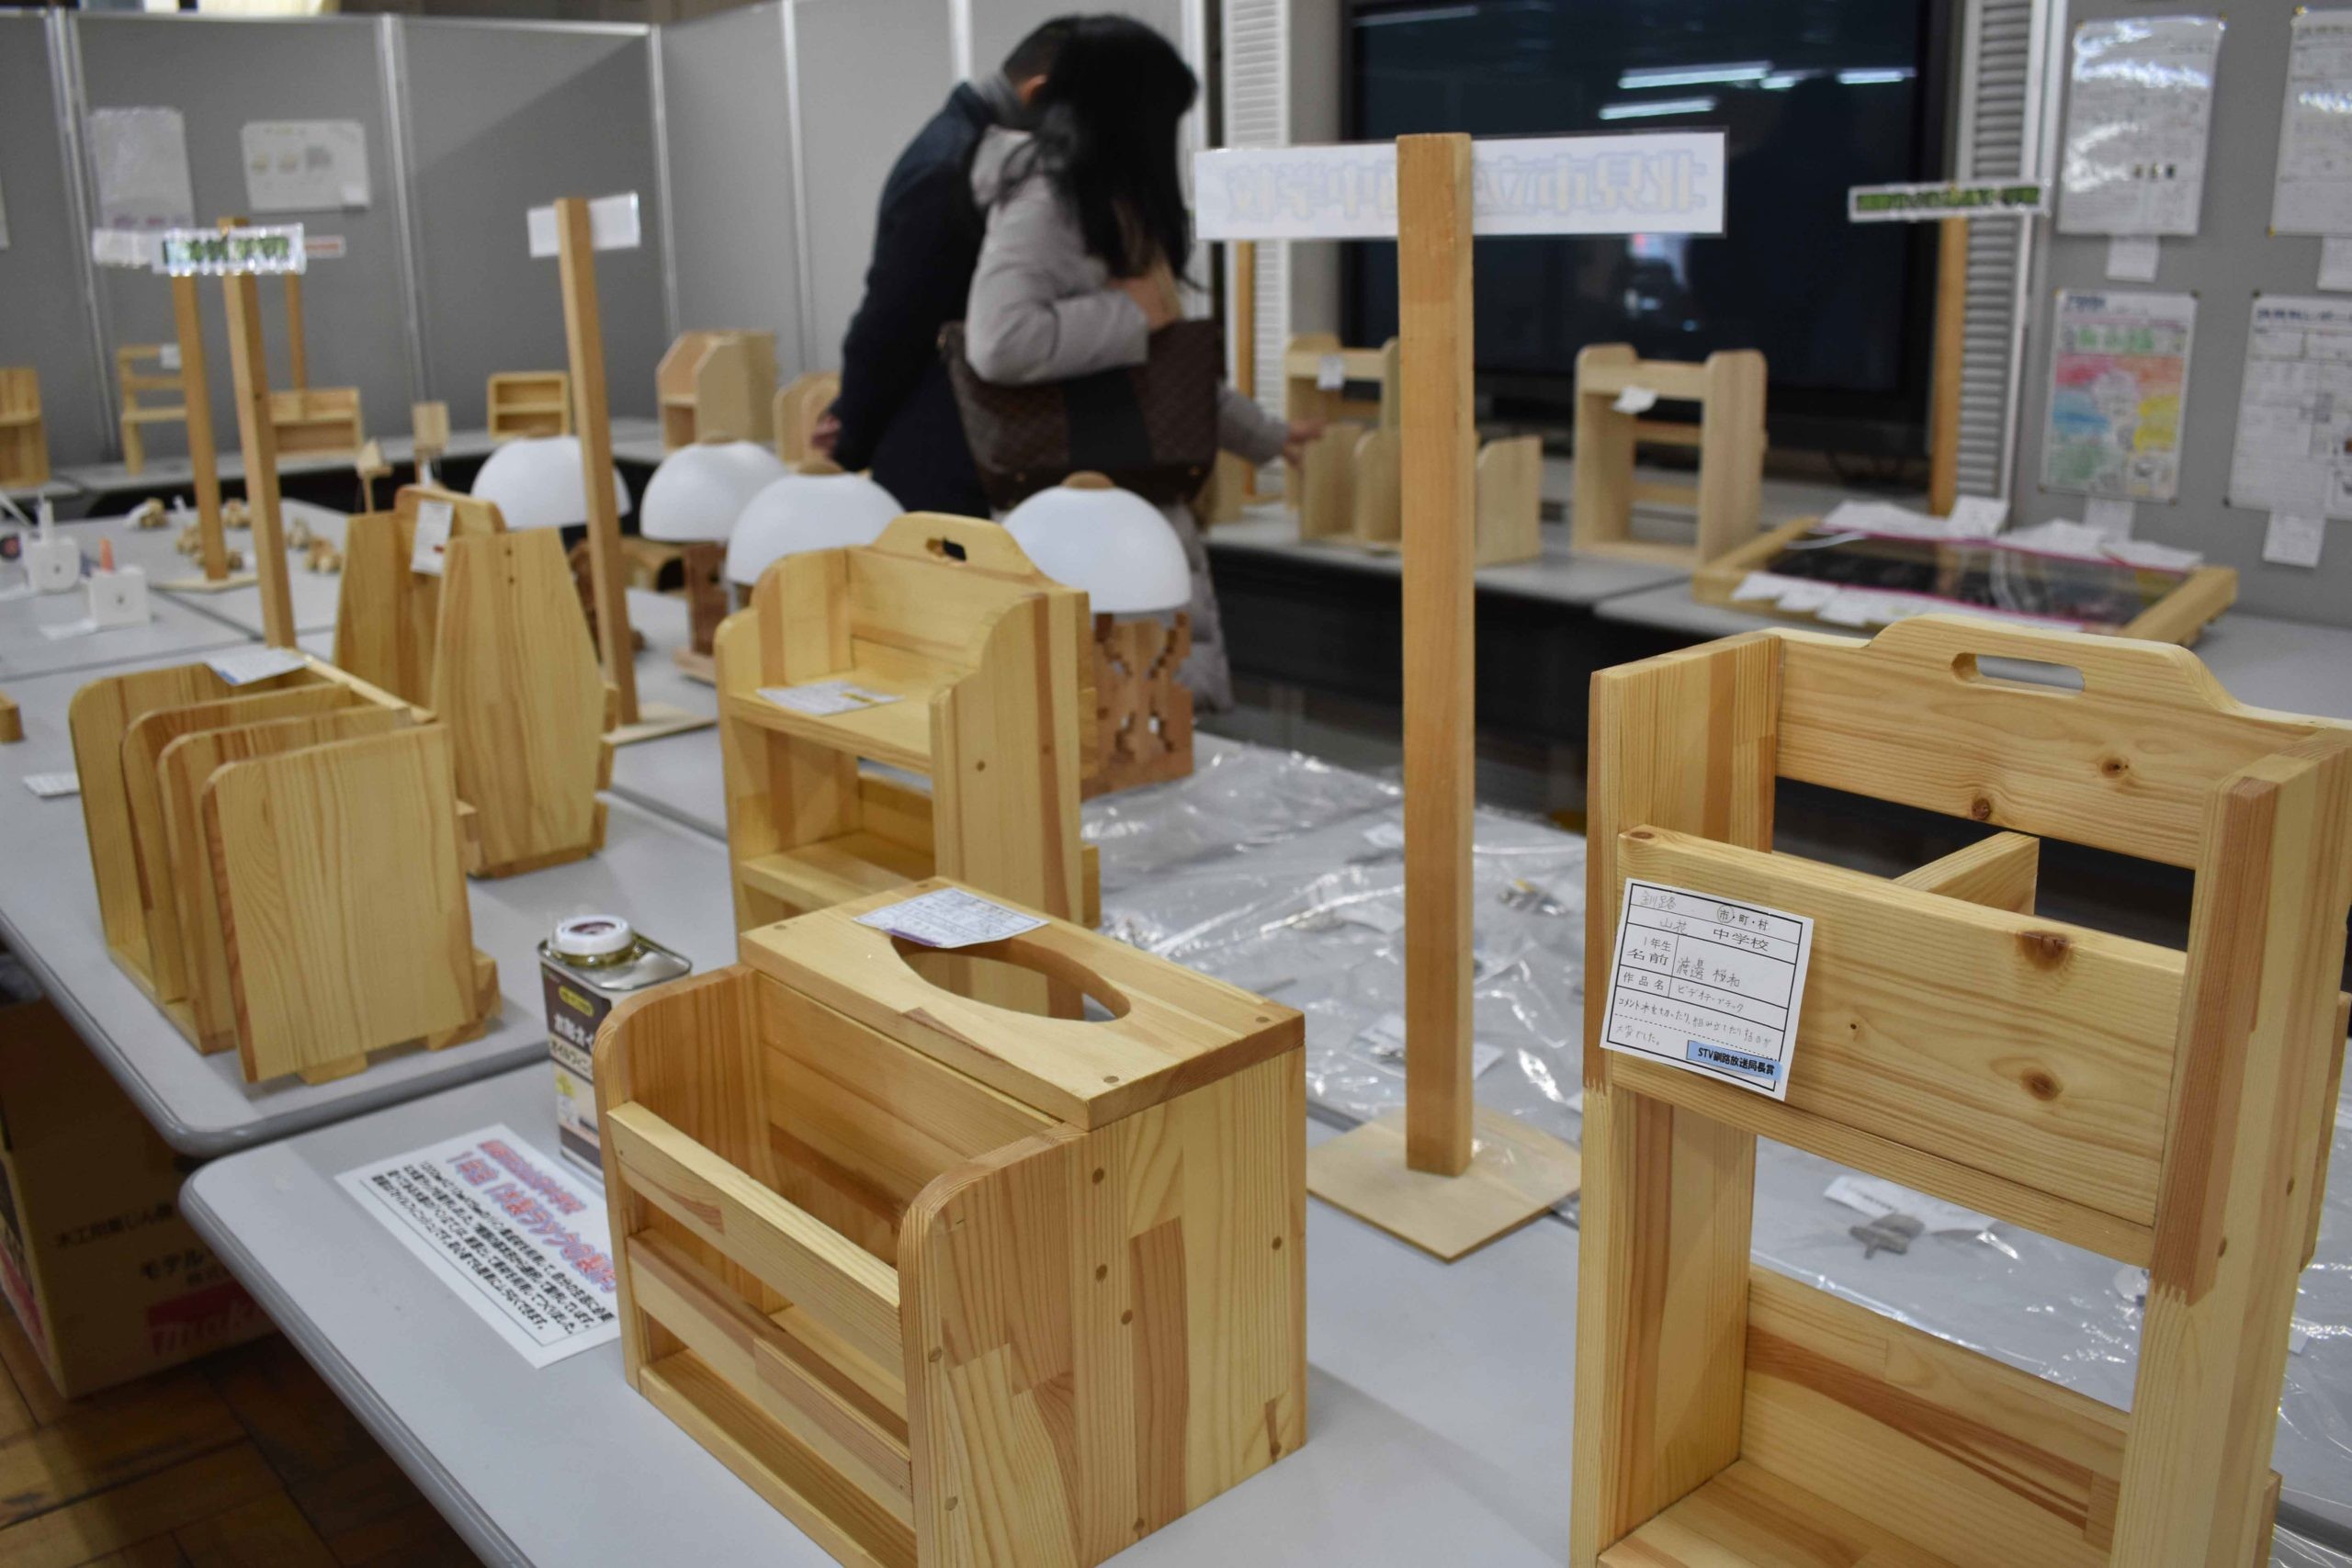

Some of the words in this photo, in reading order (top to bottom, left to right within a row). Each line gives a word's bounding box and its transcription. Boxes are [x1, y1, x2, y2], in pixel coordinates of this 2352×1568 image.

[1713, 928, 1770, 953] 中学校
[1623, 971, 1665, 992] 作品名
